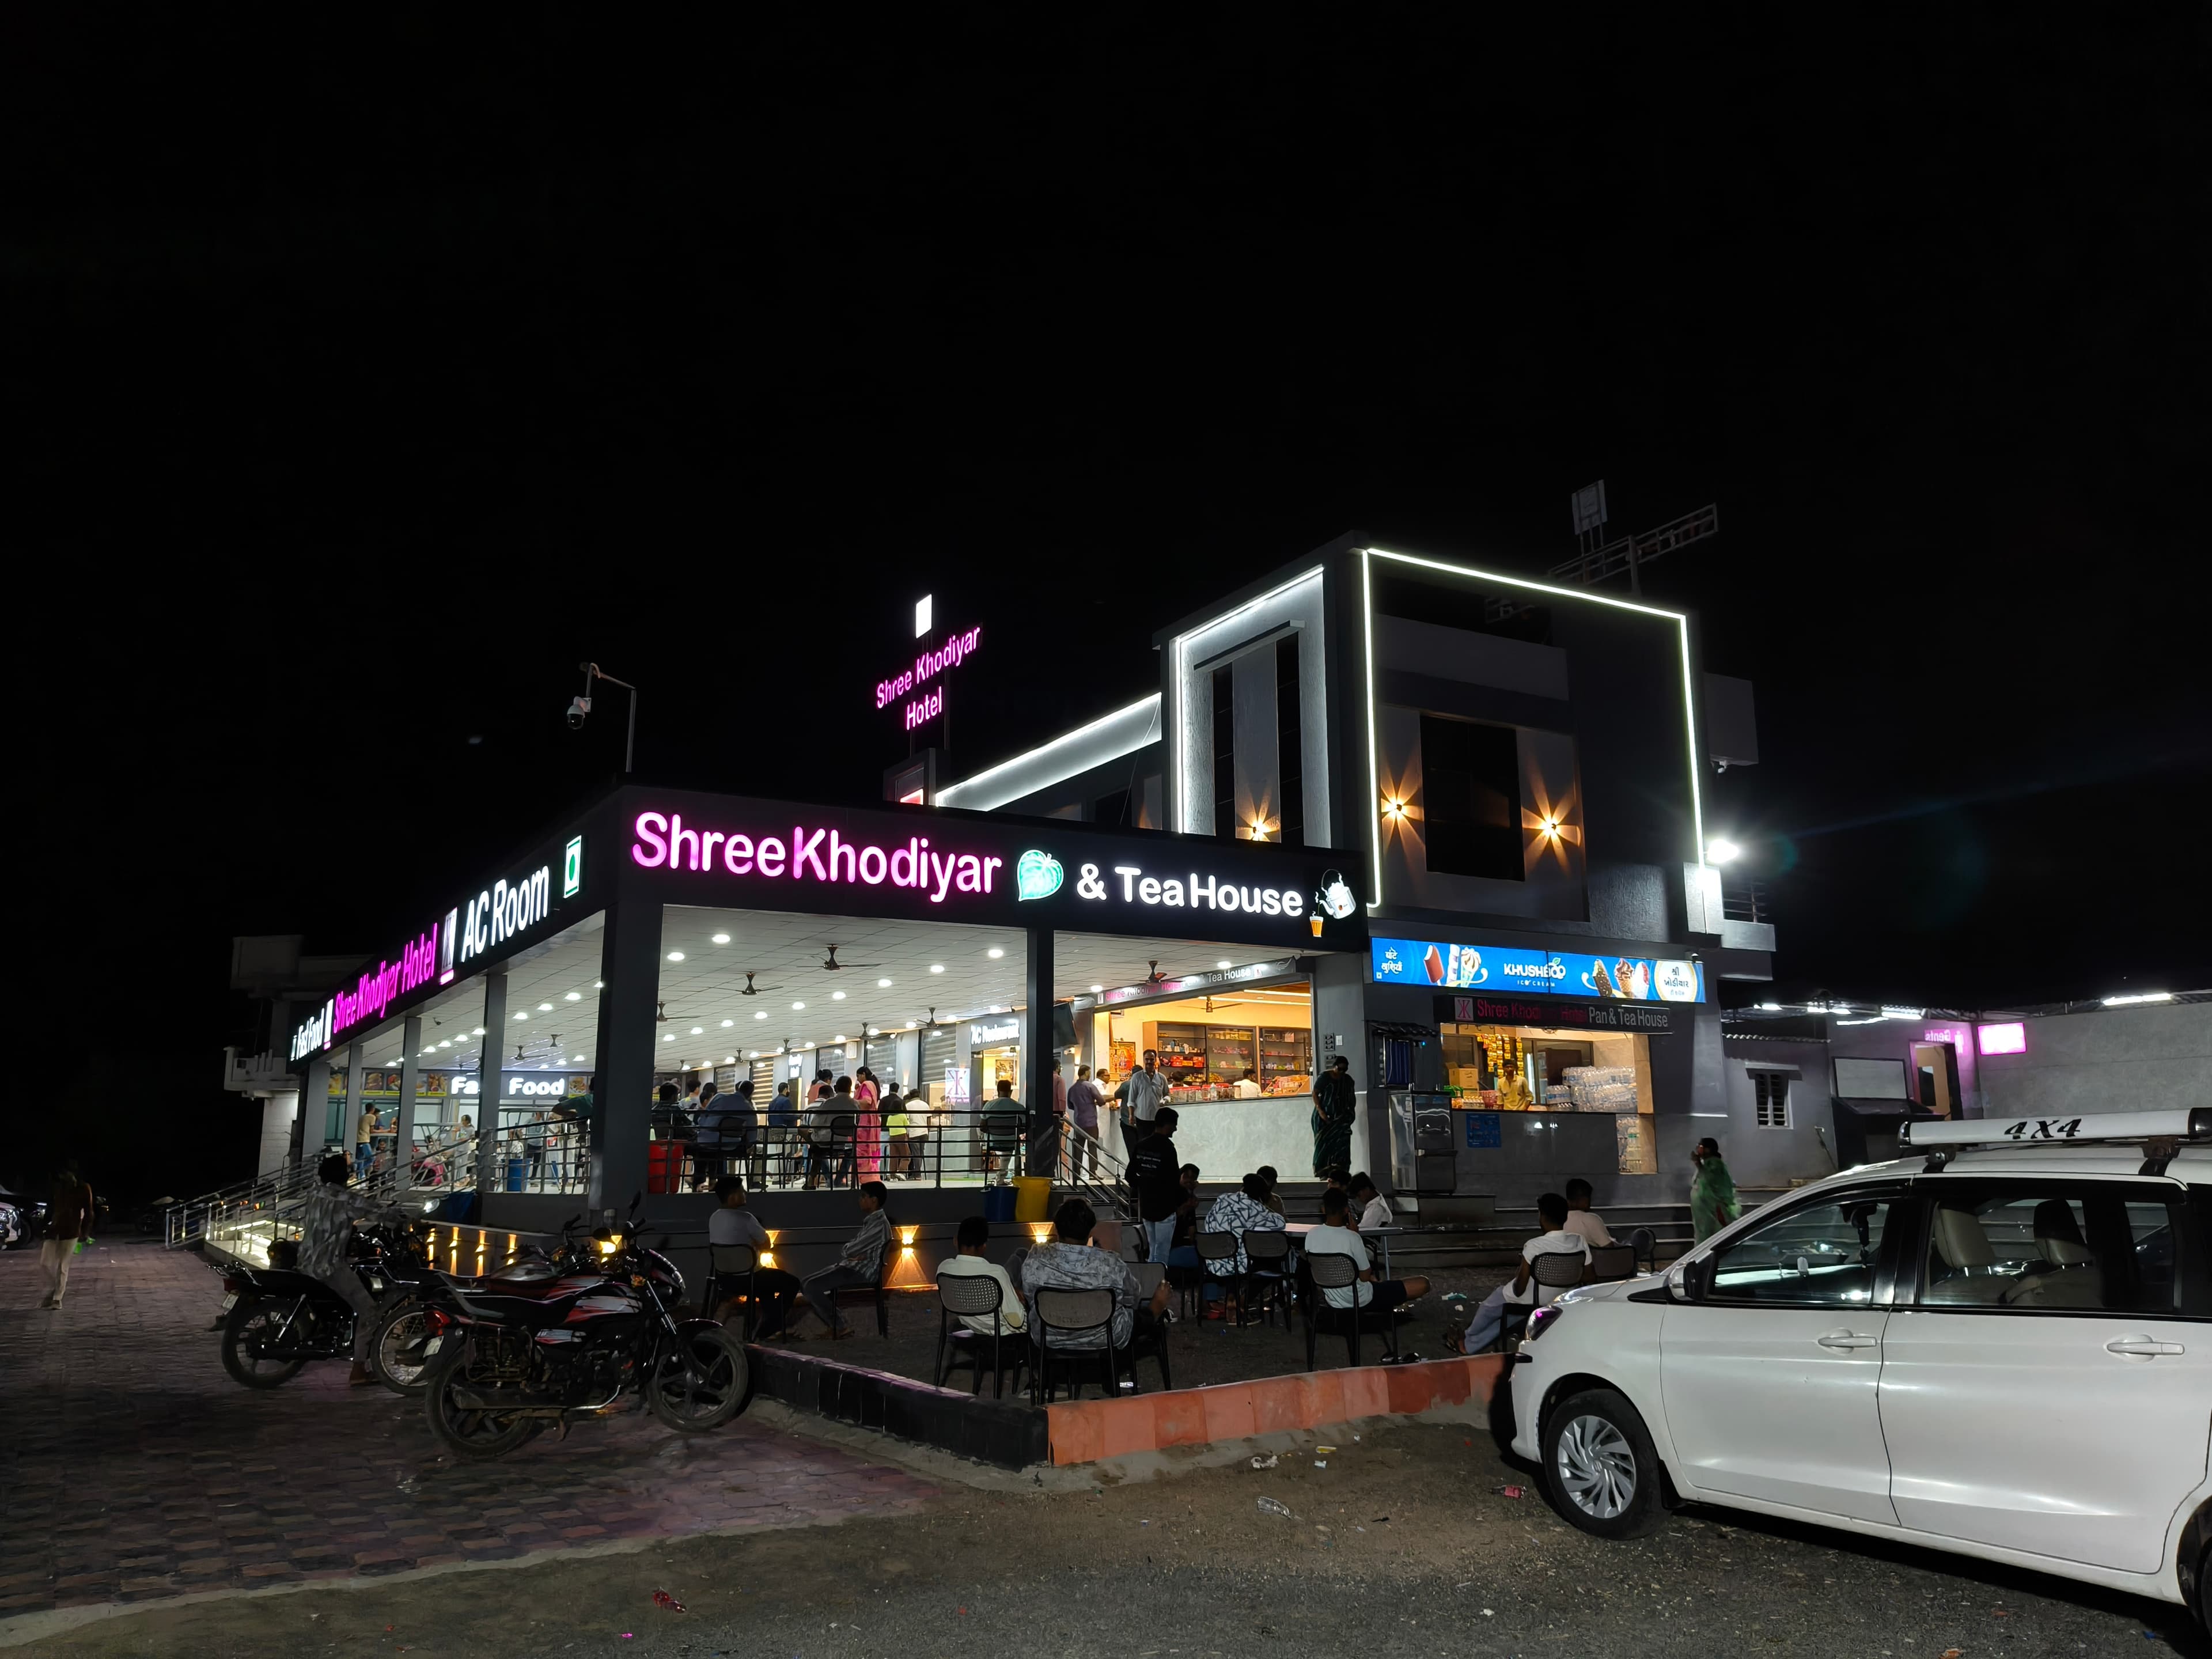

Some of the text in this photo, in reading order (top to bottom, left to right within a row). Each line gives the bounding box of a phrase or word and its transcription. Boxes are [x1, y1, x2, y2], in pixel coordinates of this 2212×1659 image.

[877, 627, 980, 709] Shree Khodiyar
[907, 685, 942, 730] Hotel
[632, 812, 1002, 903] Shree Khodiyar
[461, 866, 550, 963] AC Room
[1076, 863, 1303, 917] & Tea House
[333, 922, 438, 1035] Shree Khodiyar Hotel
[1207, 972, 1222, 983] Tea
[1224, 968, 1251, 980] House
[1477, 999, 1509, 1018] Shree
[1589, 1006, 1608, 1024] Pan
[1608, 1009, 1616, 1025] &
[1618, 1008, 1636, 1026] Tea
[1637, 1010, 1668, 1028] House
[451, 1076, 565, 1096] Fa Food
[2004, 1118, 2082, 1140] 4X4
